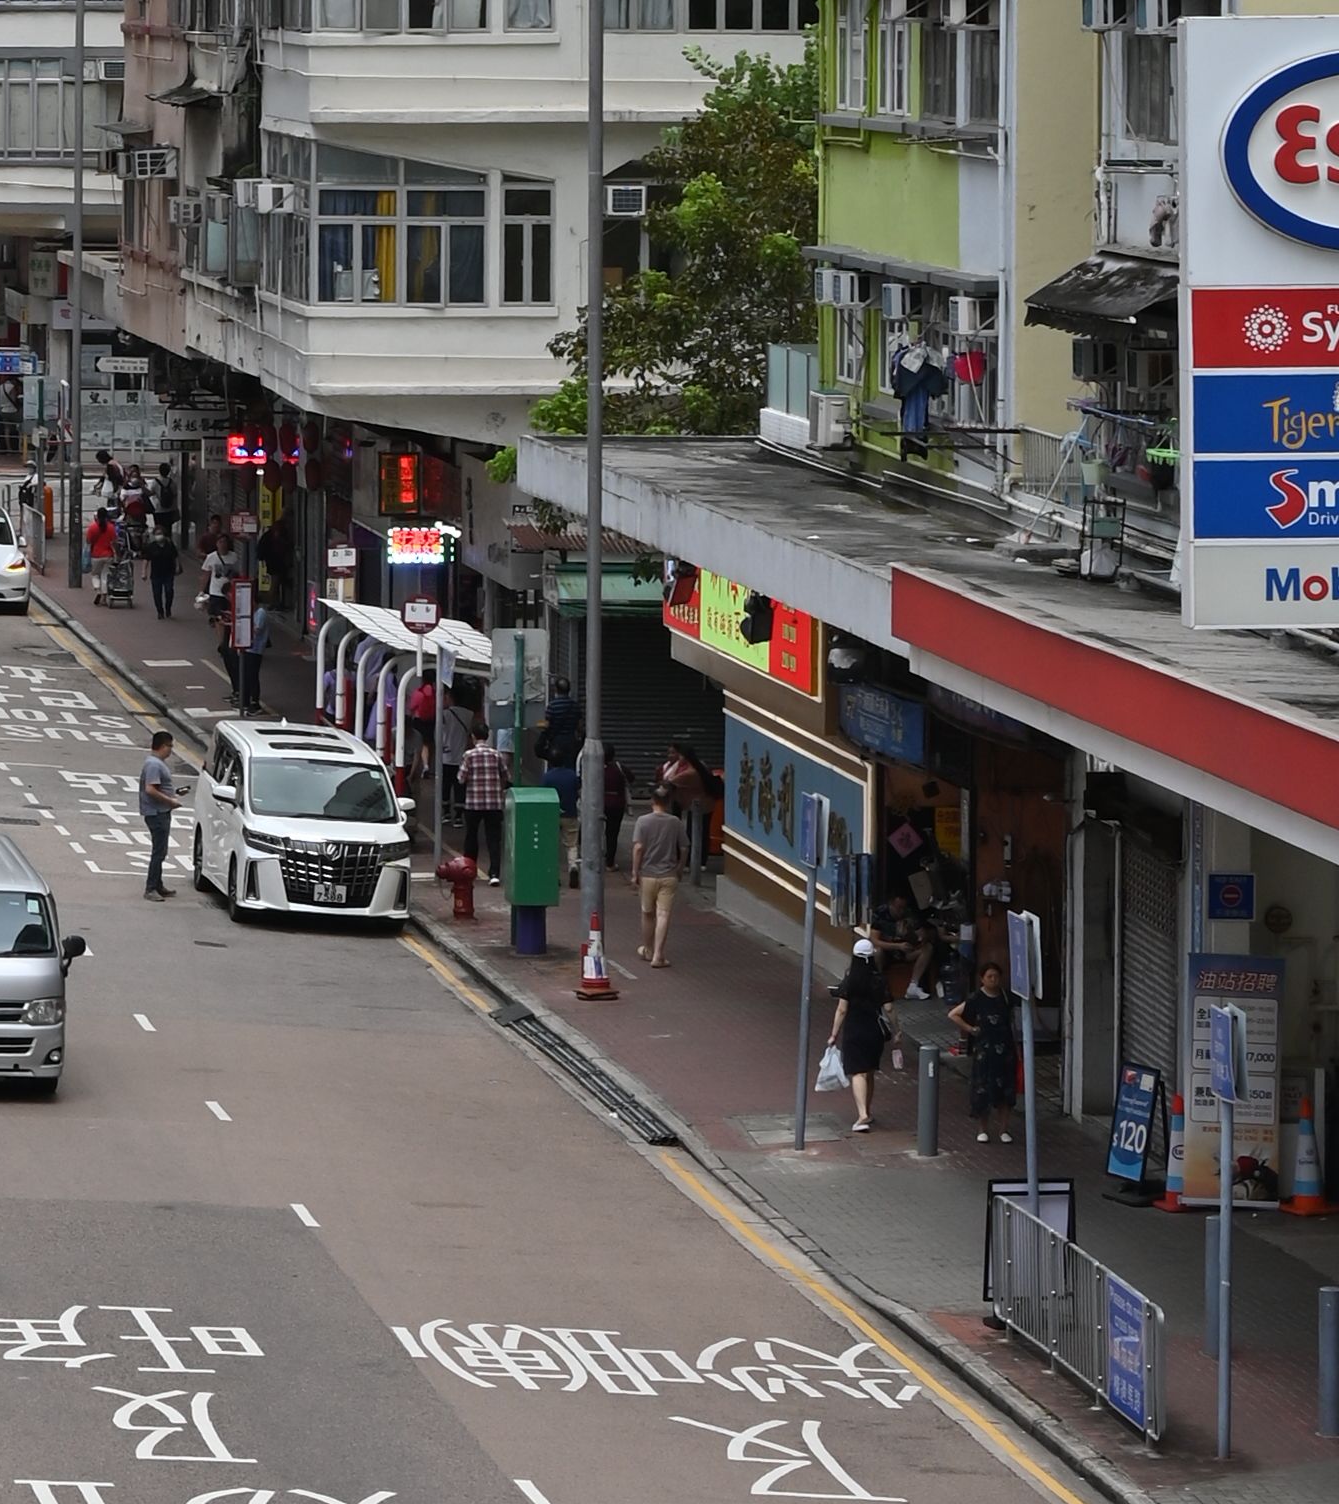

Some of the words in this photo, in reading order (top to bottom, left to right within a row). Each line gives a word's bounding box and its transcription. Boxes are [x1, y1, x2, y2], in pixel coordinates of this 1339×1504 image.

[0, 724, 135, 746] BUS
[1196, 970, 1279, 993] 油站招聘
[90, 1385, 258, 1464] 及
[669, 1416, 909, 1503] 及
